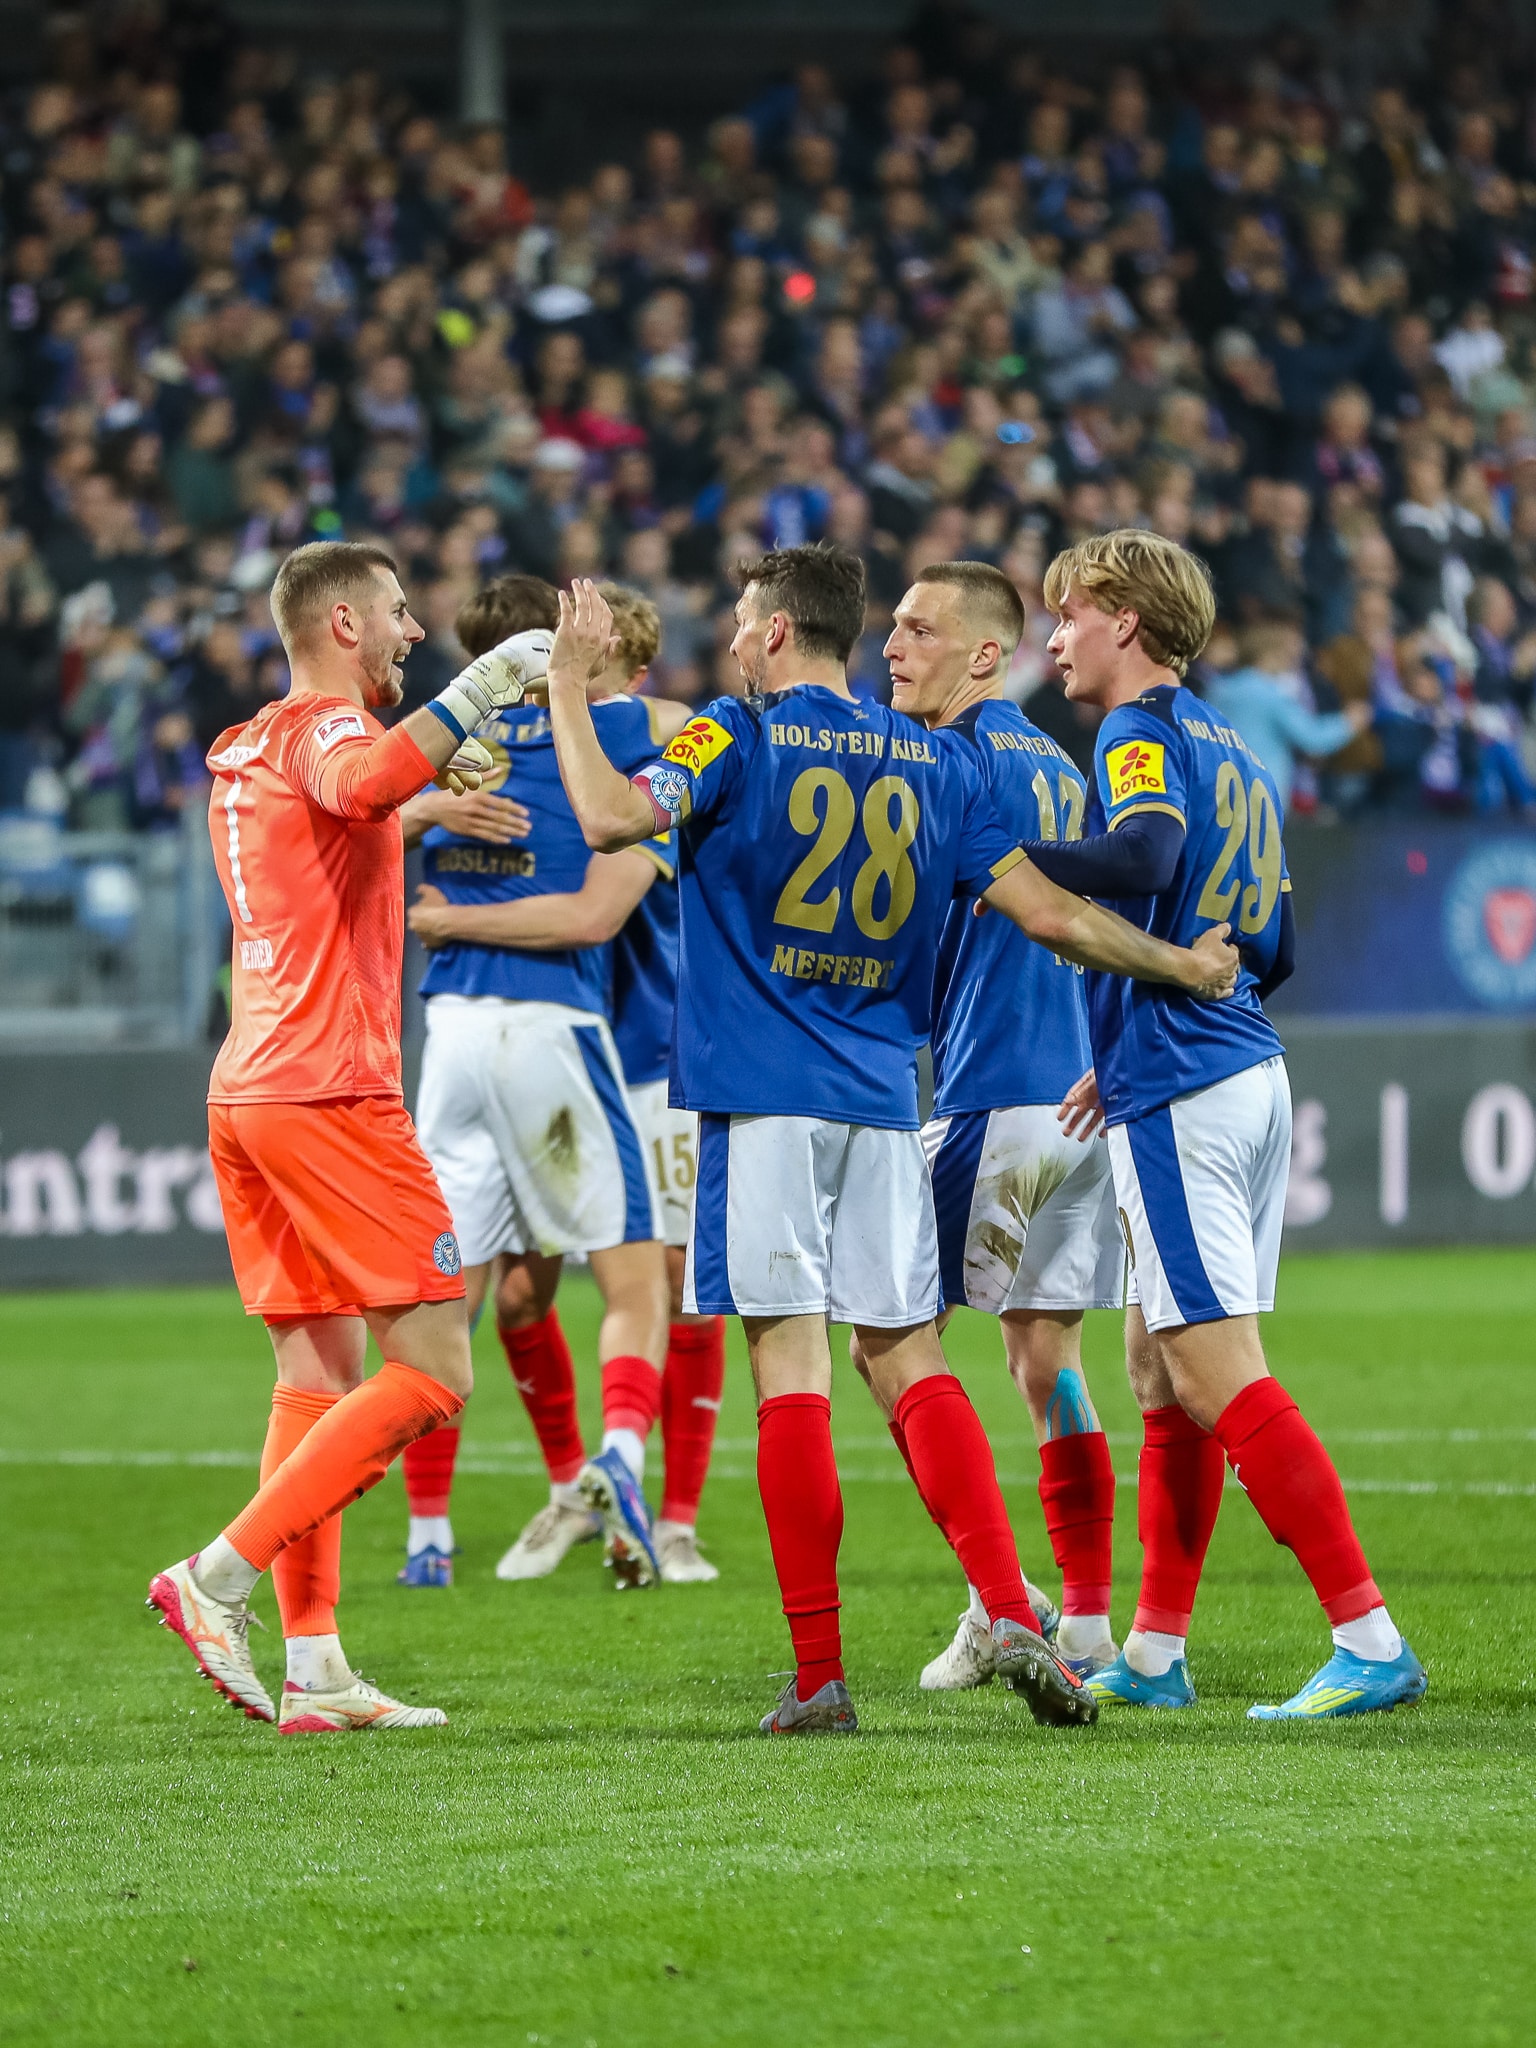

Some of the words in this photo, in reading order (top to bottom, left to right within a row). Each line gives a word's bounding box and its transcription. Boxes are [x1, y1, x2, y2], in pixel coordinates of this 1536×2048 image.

[770, 724, 884, 759] HOLSTEIN
[891, 737, 937, 764] KIEL
[1114, 773, 1161, 800] LOTTO
[223, 773, 253, 923] 1
[773, 767, 920, 941] 28
[1196, 760, 1282, 935] 29
[769, 944, 895, 989] MEFFERT
[653, 1132, 696, 1191] 15
